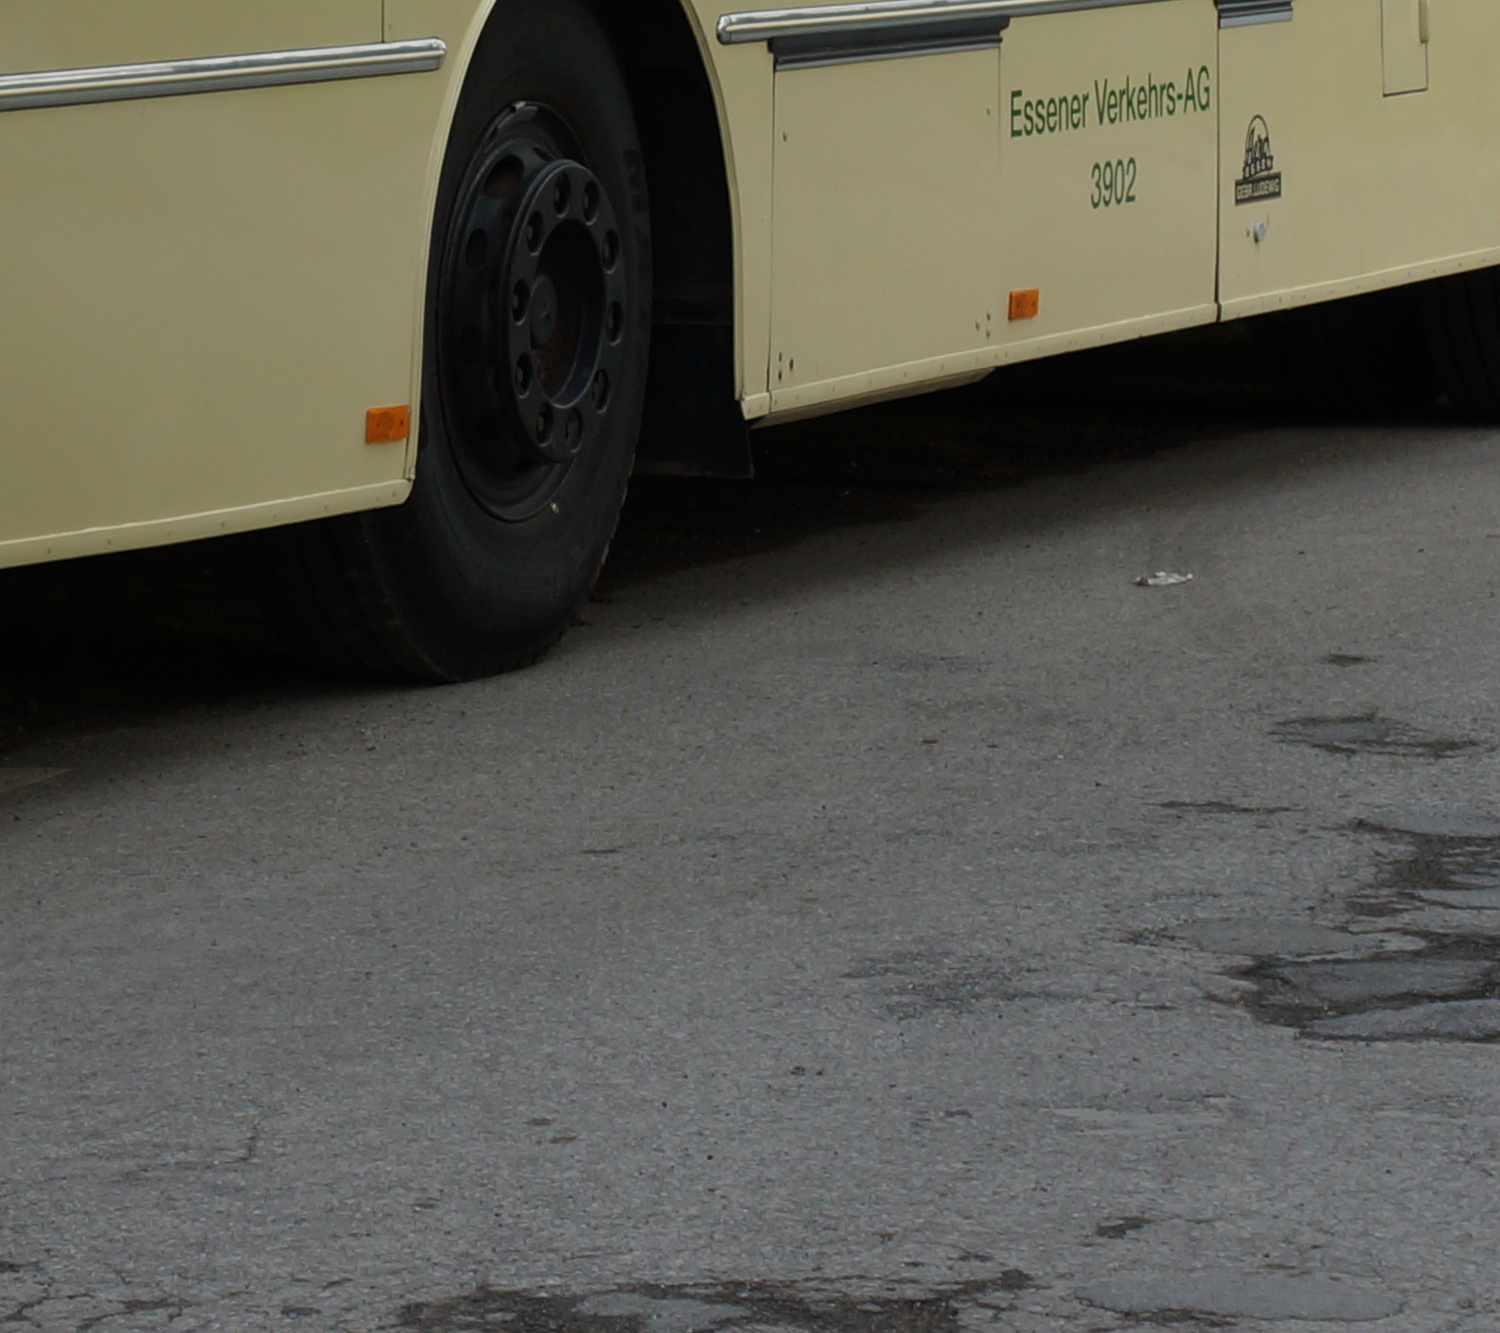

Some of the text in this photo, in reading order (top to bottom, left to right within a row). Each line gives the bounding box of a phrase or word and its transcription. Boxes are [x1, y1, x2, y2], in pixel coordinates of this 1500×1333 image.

[1010, 65, 1211, 138] Essener Verkehrs-AG
[1090, 157, 1137, 209] 3902
